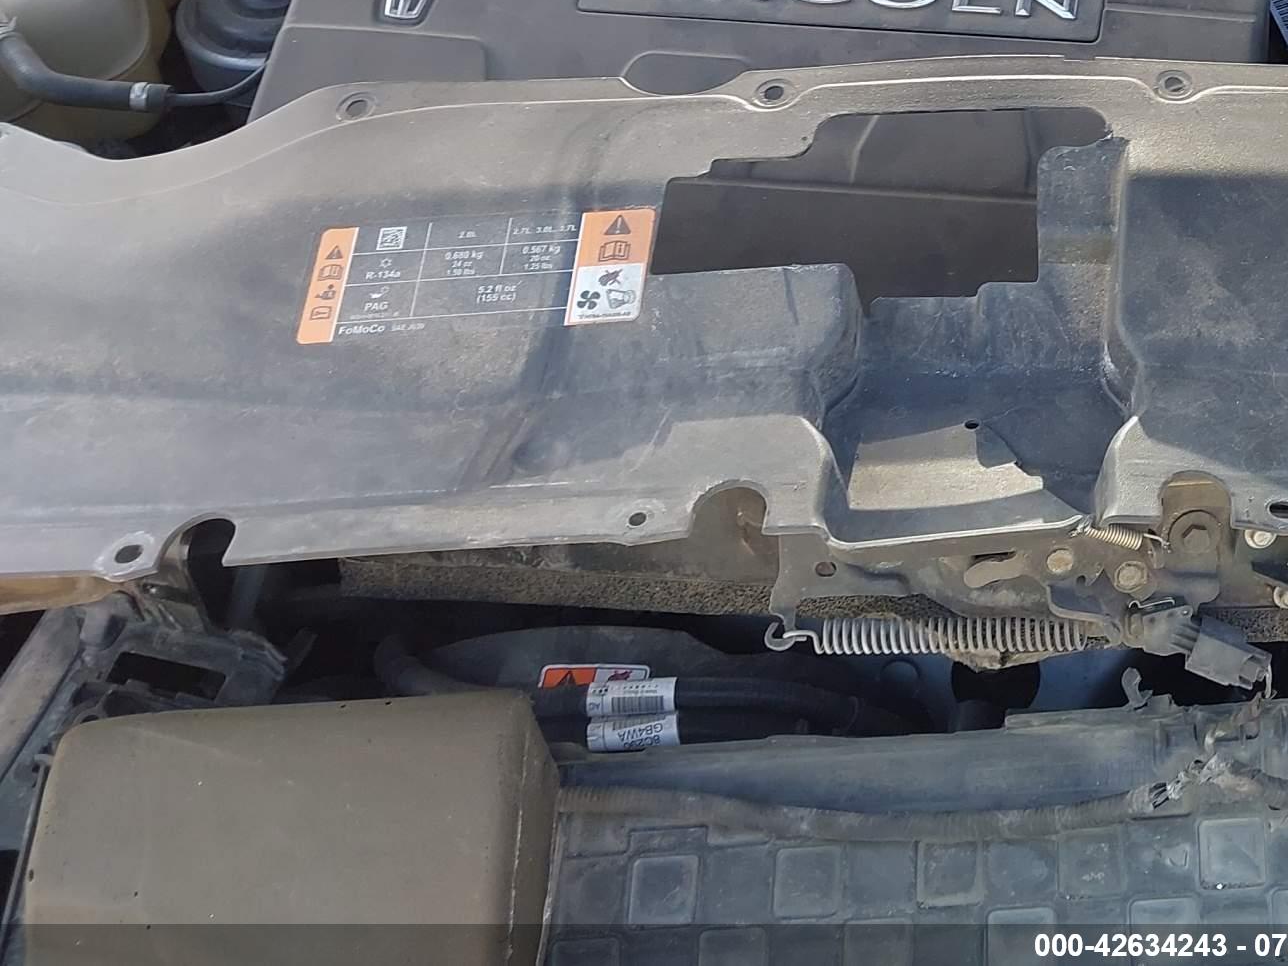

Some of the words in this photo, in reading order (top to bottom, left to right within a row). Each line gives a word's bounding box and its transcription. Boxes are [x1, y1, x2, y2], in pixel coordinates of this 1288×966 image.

[365, 269, 401, 280] R-134a
[476, 293, 499, 304] (155
[364, 300, 389, 312] PAG
[338, 323, 386, 336] FoMoCo
